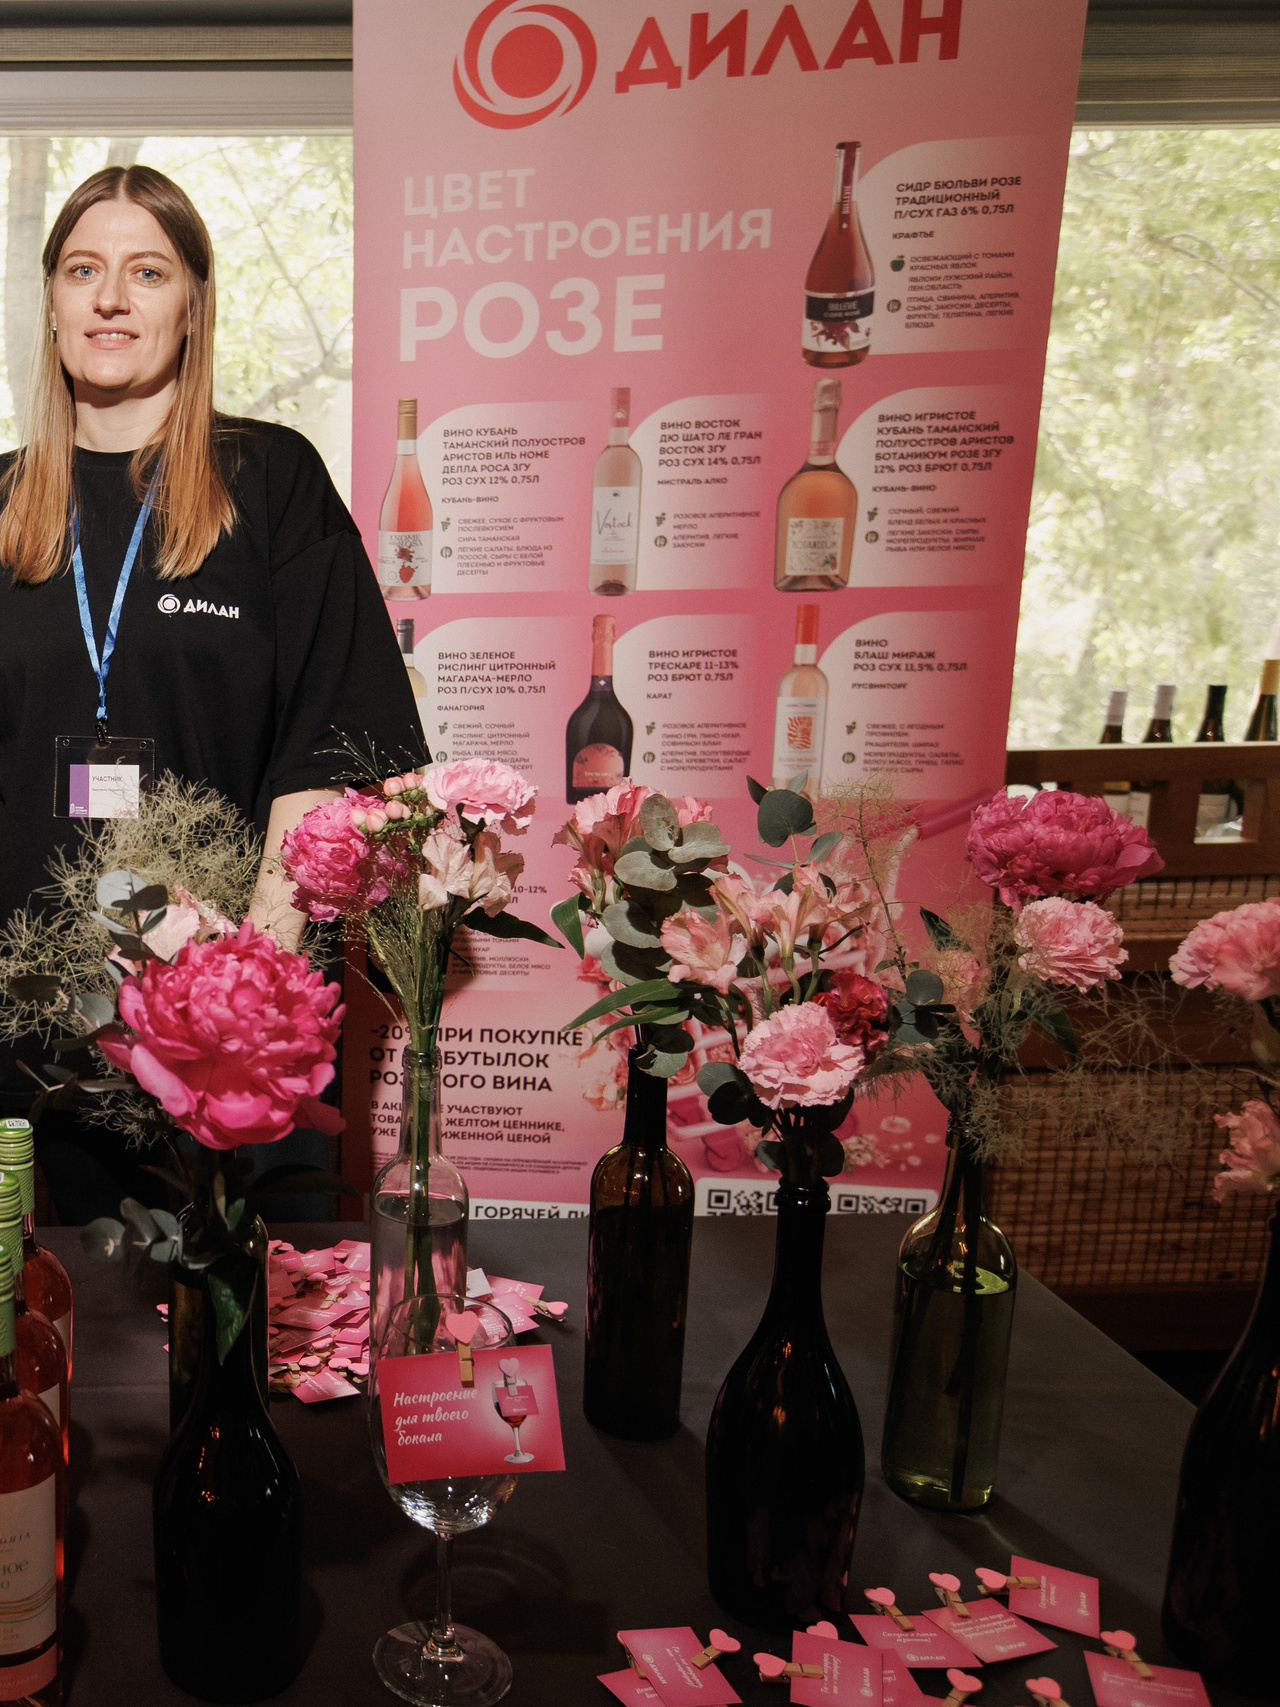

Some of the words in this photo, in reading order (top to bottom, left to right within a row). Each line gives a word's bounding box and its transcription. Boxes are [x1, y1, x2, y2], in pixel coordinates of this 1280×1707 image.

[614, 0, 961, 94] ДИЛАН
[896, 182, 931, 192] СИДР
[934, 179, 987, 190] БЮЛЬВИ
[991, 176, 1022, 186] РОЗЕ
[402, 167, 536, 219] ЦВЕТ
[895, 189, 1000, 206] ТРАДИЦИОННЫЙ
[936, 208, 957, 217] ГАЗ
[960, 206, 978, 215] 6%
[402, 208, 772, 270] НАСТРОЕНИЯ
[399, 274, 667, 362] РОЗЕ
[878, 413, 912, 423] ВИНО
[914, 411, 976, 422] ИГРИСТОЕ
[660, 421, 691, 430] ВИНО
[695, 419, 740, 429] ВОСТОК
[876, 425, 923, 435] КУБАНЬ
[926, 421, 1000, 434] ТАМАНСКИЙ
[443, 429, 473, 438] ВИНО
[476, 427, 518, 436] КУБАНЬ
[659, 434, 679, 443] ДЮ
[682, 433, 715, 442] ШАТО
[717, 432, 731, 441] ЛЕ
[734, 431, 763, 440] ГРАН
[443, 438, 509, 450] ТАМАНСКИЙ
[512, 437, 586, 447] ПОЛУОСТРОВ
[876, 437, 957, 448] ПОЛУОСТРОВ
[959, 435, 1014, 446] АРИСТОВ
[442, 452, 493, 461] АРИСТОВ
[495, 452, 517, 460] ИЛЬ
[520, 451, 550, 459] НОМЕ
[659, 445, 704, 455] ВОСТОК
[707, 445, 726, 454] ЗГУ
[874, 451, 948, 461] БОТАНИКУМ
[950, 450, 980, 459] РОЗЕ
[659, 458, 680, 467] РОЗ
[683, 458, 704, 466] СУХ
[707, 457, 728, 465] 14%
[899, 463, 922, 473] РОЗ
[925, 463, 959, 472] БРЮТ
[442, 465, 478, 474] ДЕЛЛА
[480, 464, 510, 472] РОСА
[512, 463, 530, 472] ЗГУ
[442, 477, 463, 486] РОЗ
[465, 477, 487, 485] СУХ
[489, 476, 509, 484] 12%
[441, 496, 499, 504] КУБАНЬ-ВИНО
[183, 599, 239, 619] ДИЛАН
[855, 639, 888, 647] ВИНО
[438, 652, 467, 660] ВИНО
[470, 651, 515, 659] ЗЕЛЕНОЕ
[649, 650, 679, 658] ВИНО
[682, 650, 738, 658] ИГРИСТОЕ
[854, 652, 889, 660] БЛАШ
[892, 651, 935, 659] МИРАЖ
[438, 663, 485, 672] РИСЛИНГ
[489, 660, 556, 671] ЦИТРОННЫЙ
[648, 662, 702, 670] ТРЕСКАРЕ
[704, 661, 738, 669] 11-13%
[853, 663, 876, 671] РОЗ
[879, 663, 901, 671] СУХ
[438, 674, 532, 683] МАГАРАЧА-МЕРЛО
[648, 674, 669, 682] РОЗ
[671, 673, 702, 681] БРЮТ
[437, 686, 457, 694] РОЗ
[460, 686, 493, 694] П/СУХ
[480, 1028, 583, 1046] ПОКУПКЕ
[370, 1048, 397, 1062] ОТ
[444, 1051, 550, 1068] БУТЫЛОК
[370, 1070, 486, 1089] РООГО
[493, 1075, 552, 1092] ВИНА
[371, 1101, 379, 1110] В
[447, 1105, 523, 1116] УЧАСТВУЮТ
[371, 1114, 402, 1124] ТОВА
[445, 1118, 500, 1128] ЖЕЛТОМ
[370, 1127, 397, 1137] УЖЕ
[441, 1130, 504, 1141] ИЖЕННОЙ
[507, 1132, 551, 1144] ЦЕНОЙ
[475, 1205, 560, 1219] ГОРЯЧЕЙ
[393, 1388, 478, 1407] Настроение
[395, 1415, 418, 1432] для
[422, 1407, 469, 1423] твоего
[397, 1430, 443, 1446] бокала
